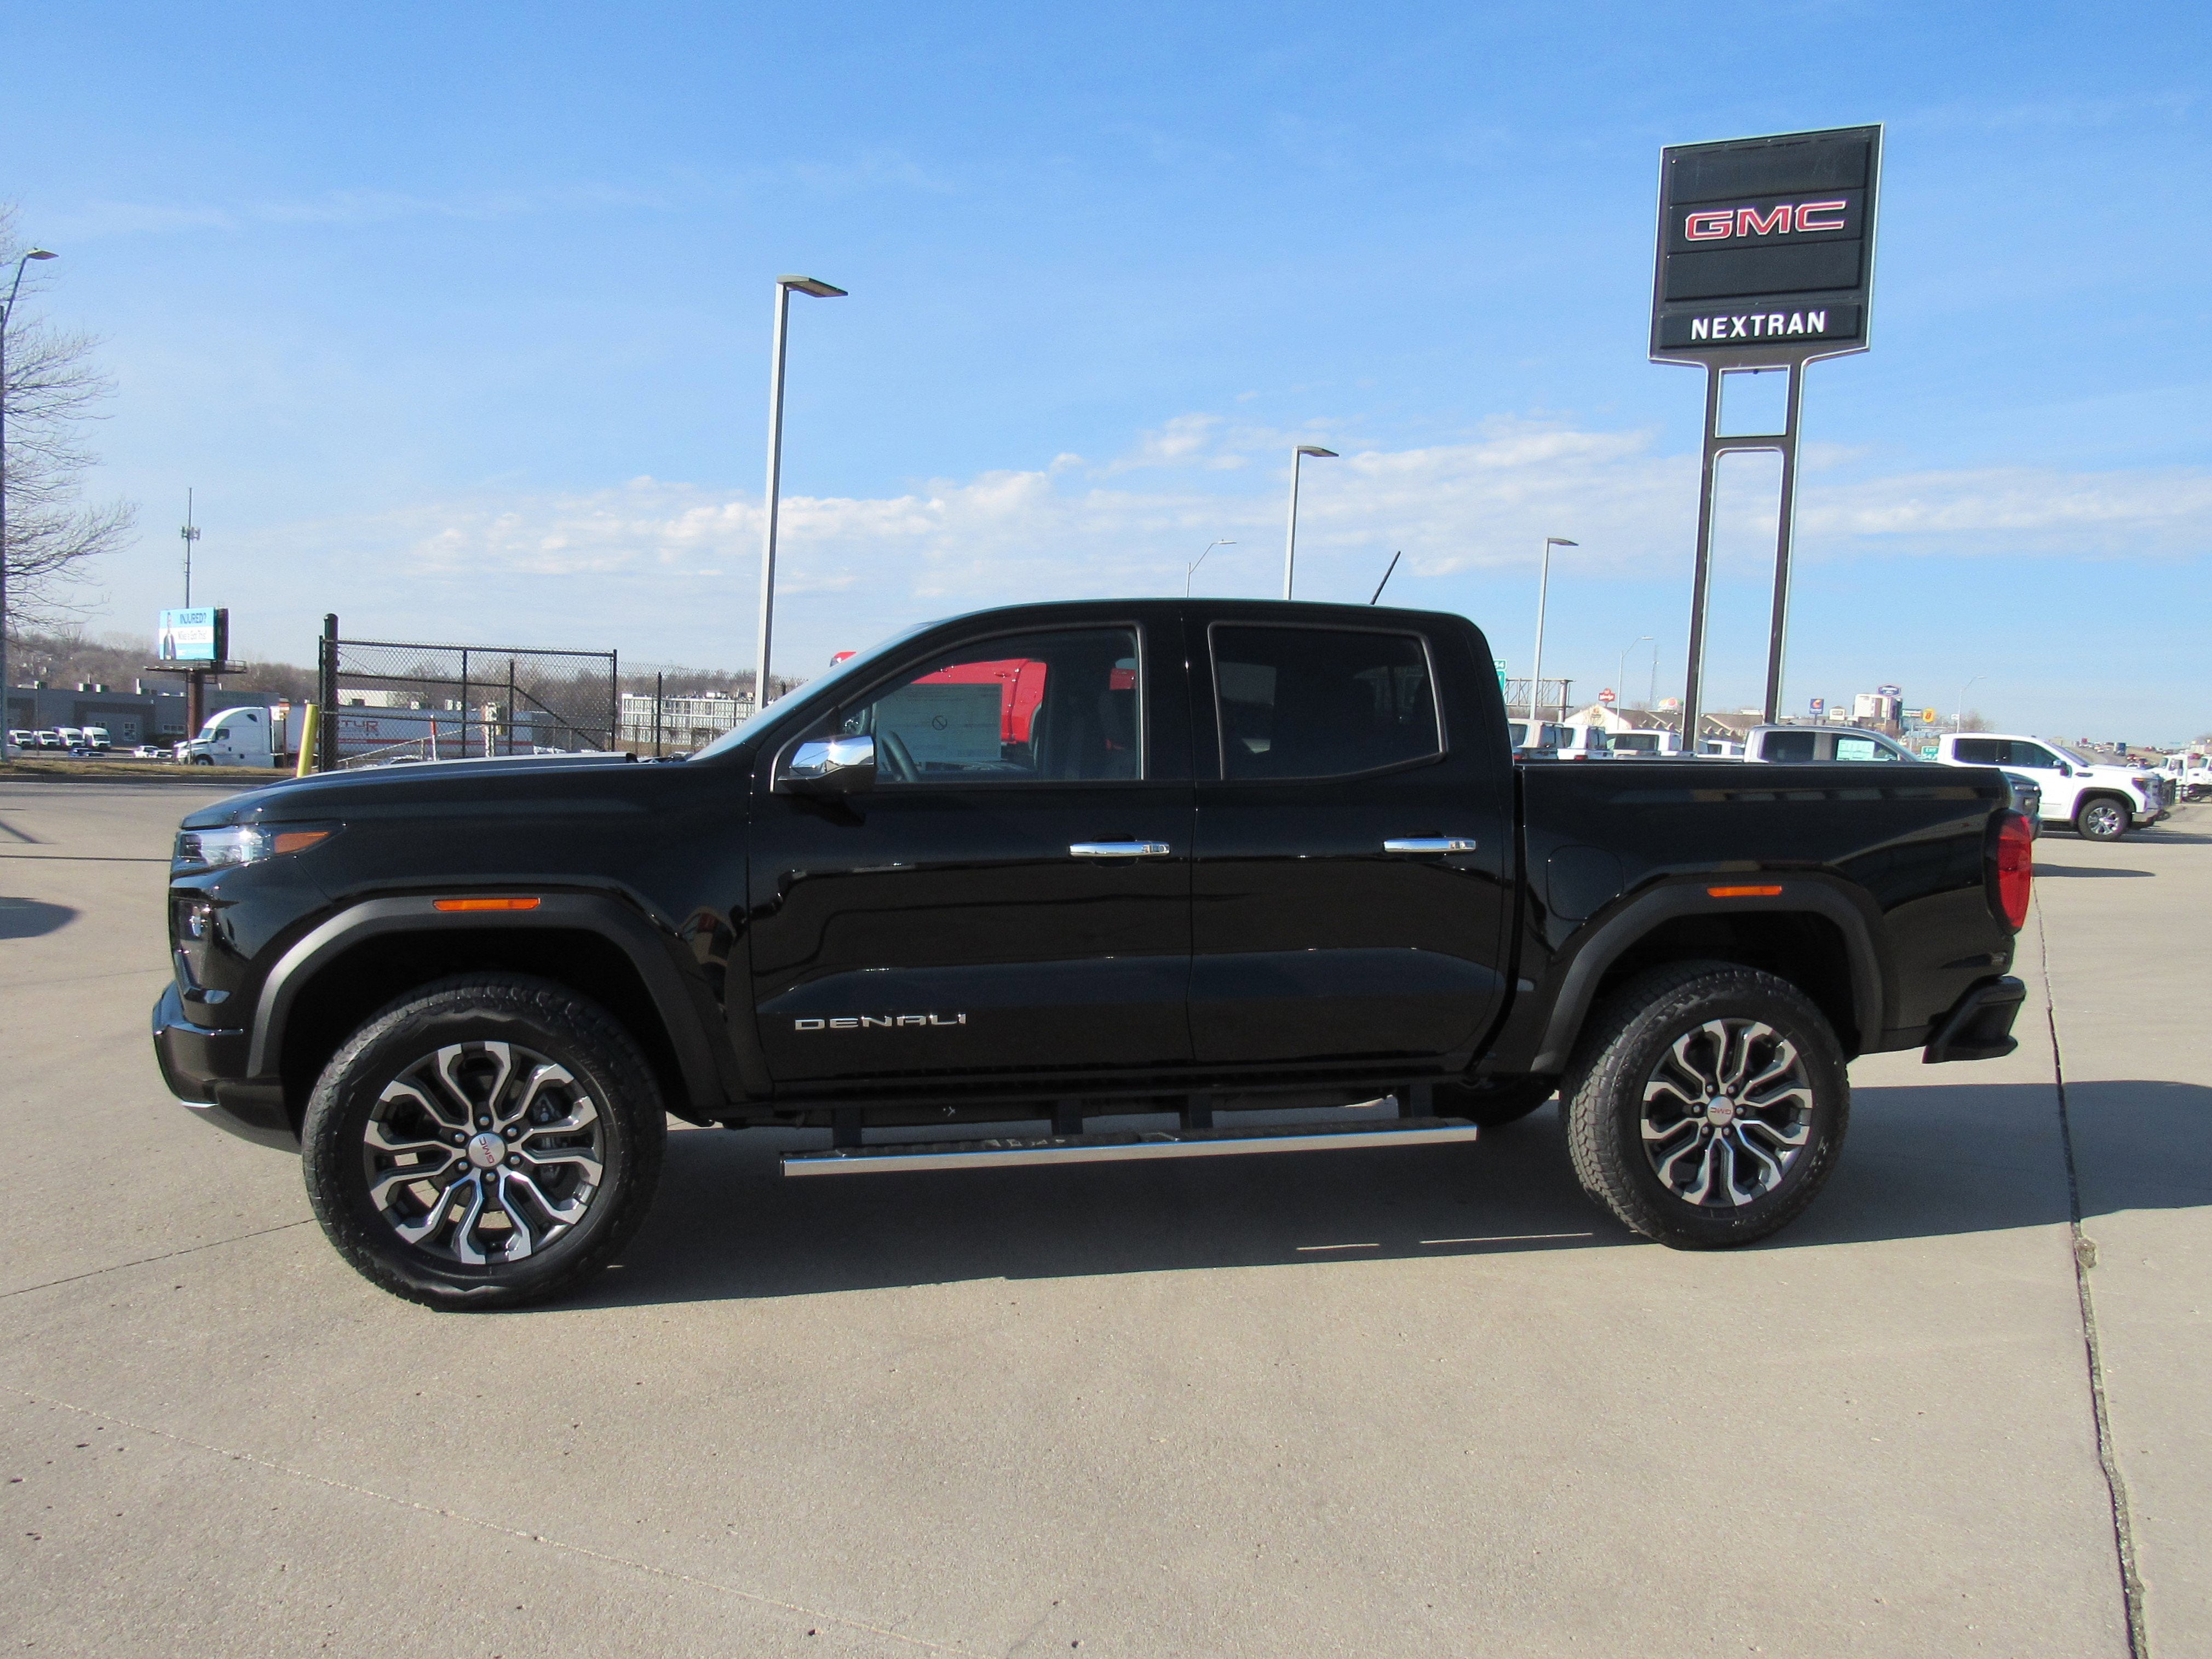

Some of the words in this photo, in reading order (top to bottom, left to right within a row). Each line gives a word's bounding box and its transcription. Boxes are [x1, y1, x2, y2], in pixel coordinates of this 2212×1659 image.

[1685, 201, 1846, 241] GMC
[1691, 311, 1825, 340] NEXTRAN
[795, 1014, 967, 1030] DENALI
[479, 1136, 494, 1164] GMC
